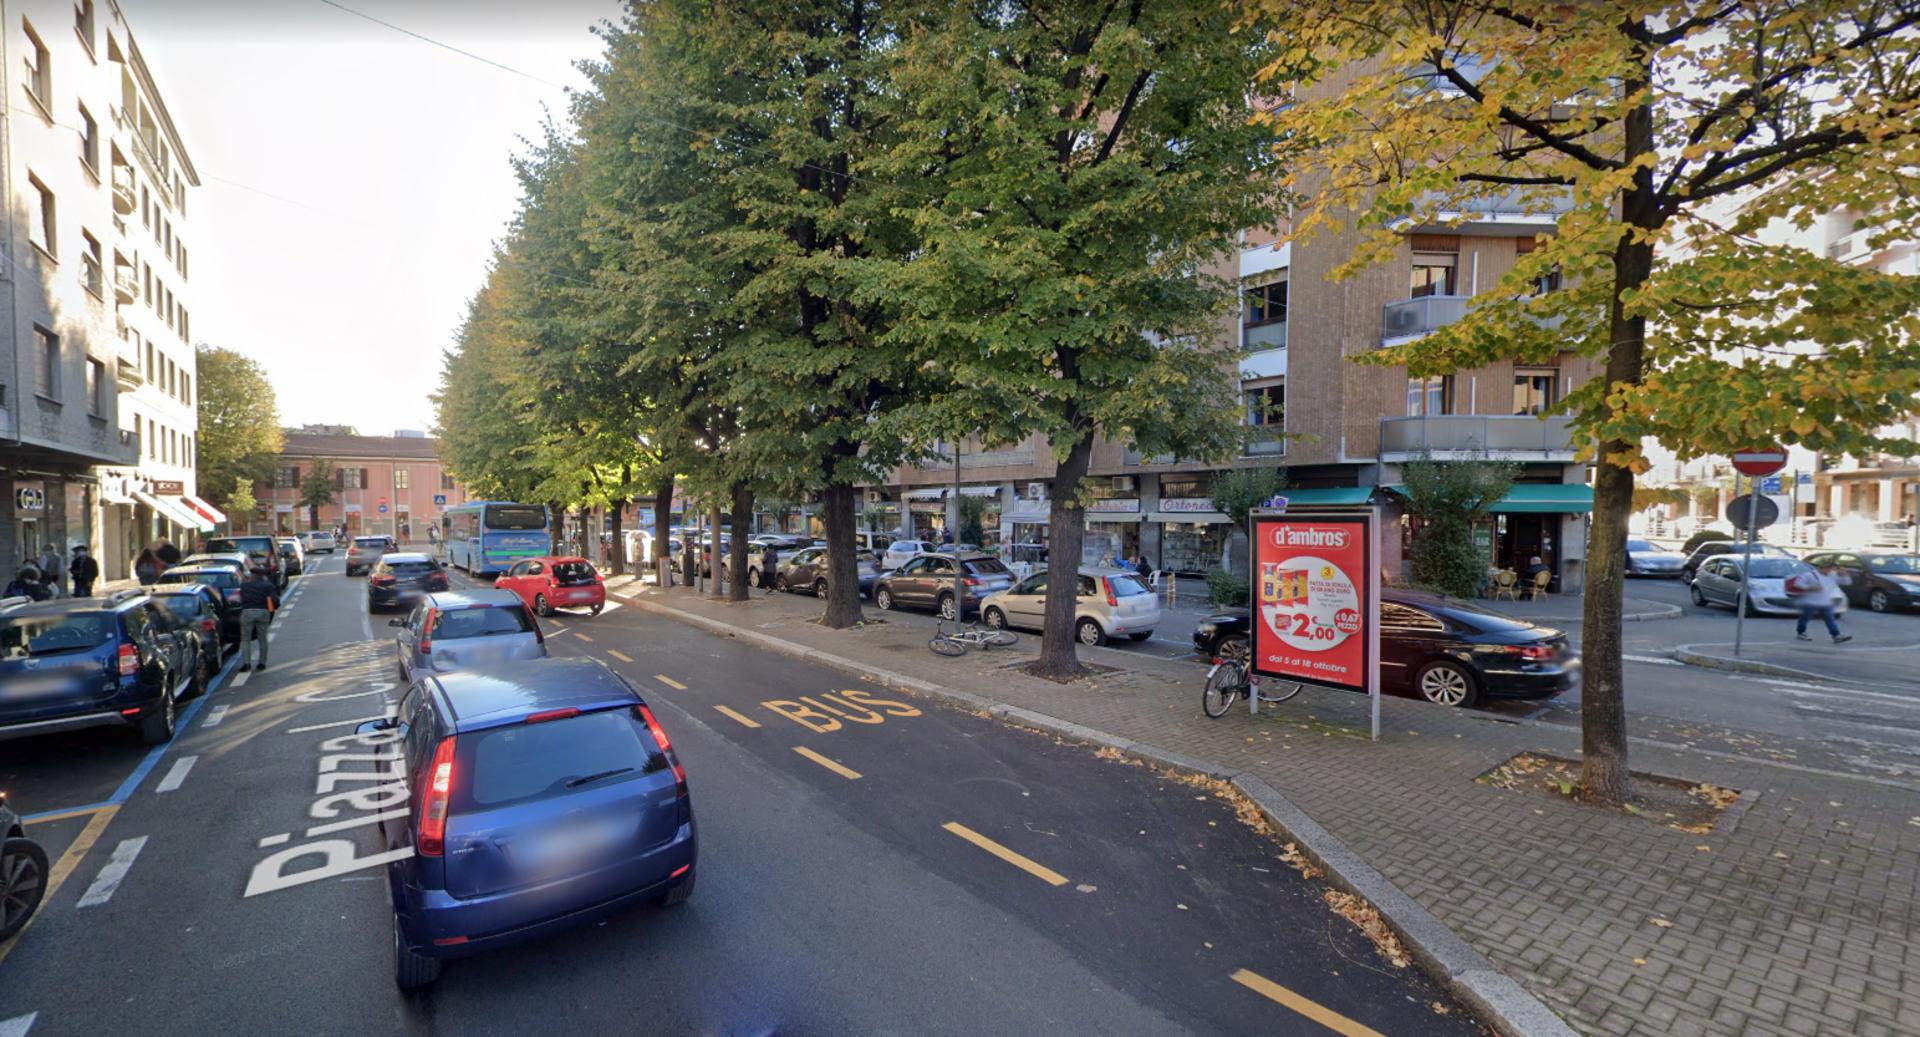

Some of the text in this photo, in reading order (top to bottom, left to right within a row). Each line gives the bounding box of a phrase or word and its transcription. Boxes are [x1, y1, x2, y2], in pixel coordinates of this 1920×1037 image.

[1275, 525, 1345, 546] d'ambros
[1269, 655, 1282, 663] dal
[1284, 656, 1290, 664] 5
[1291, 657, 1300, 666] al
[1313, 662, 1347, 673] ottobre
[760, 690, 922, 733] BUS
